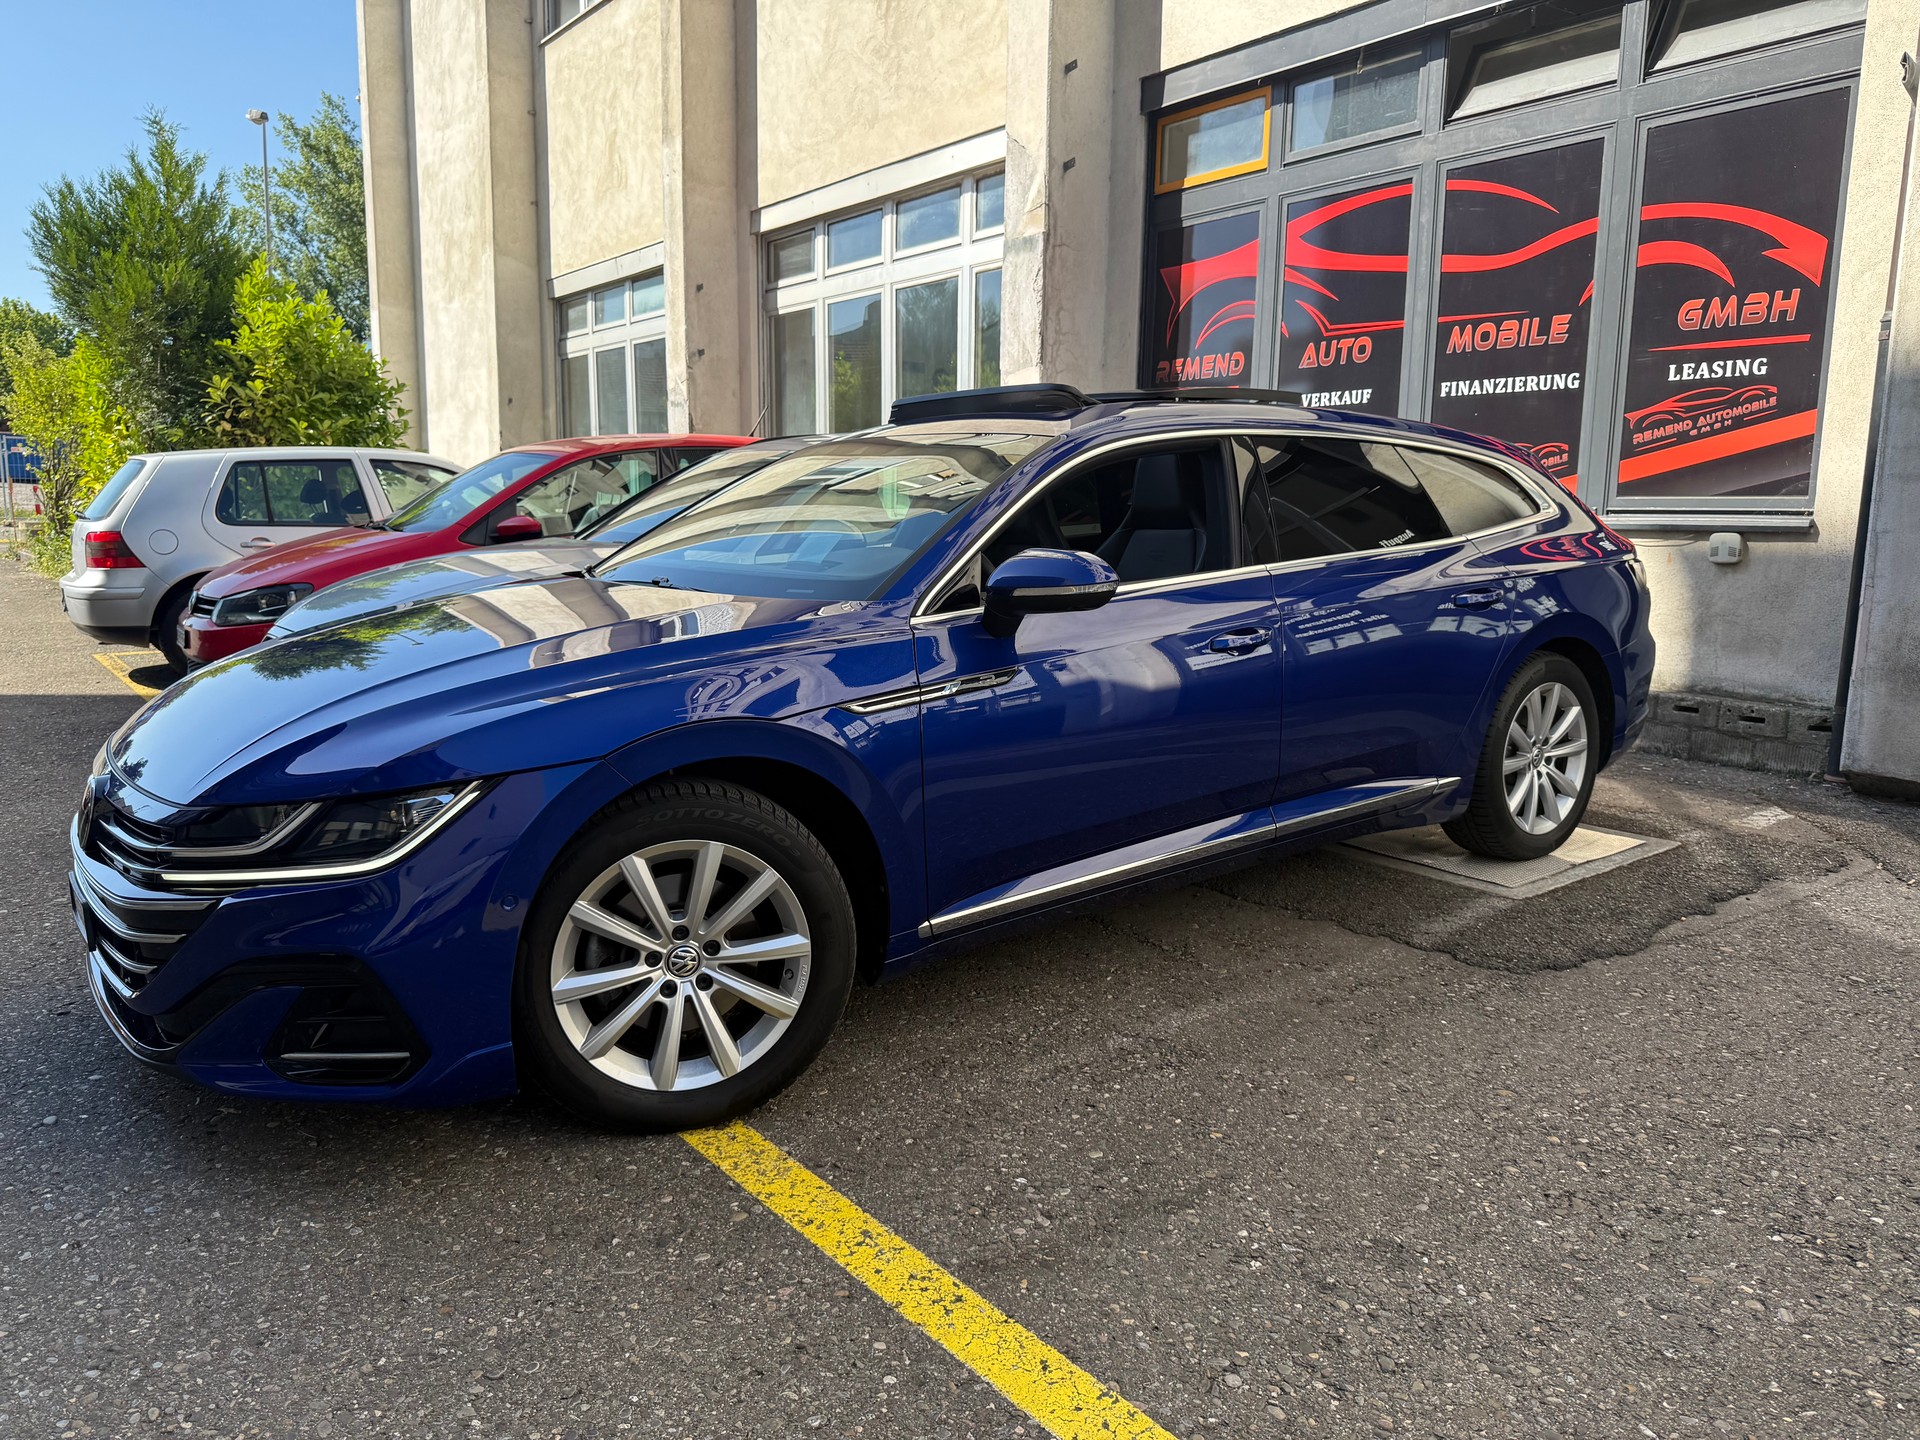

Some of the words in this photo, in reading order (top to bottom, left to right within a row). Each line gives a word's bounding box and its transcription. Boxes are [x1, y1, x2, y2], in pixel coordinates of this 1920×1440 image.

[1156, 351, 1245, 384] REMEND
[1298, 336, 1373, 369] AUTO
[1446, 313, 1573, 354] MOBILE
[1677, 288, 1801, 331] GMBH
[1440, 372, 1581, 397] FINANZIERUNG
[1667, 357, 1768, 381] LEASING
[1301, 388, 1373, 408] VERKAUF
[1632, 419, 1693, 445] REMEND
[1696, 396, 1777, 427] AUTOMOBILE
[636, 806, 793, 847] SOTTOZERO
